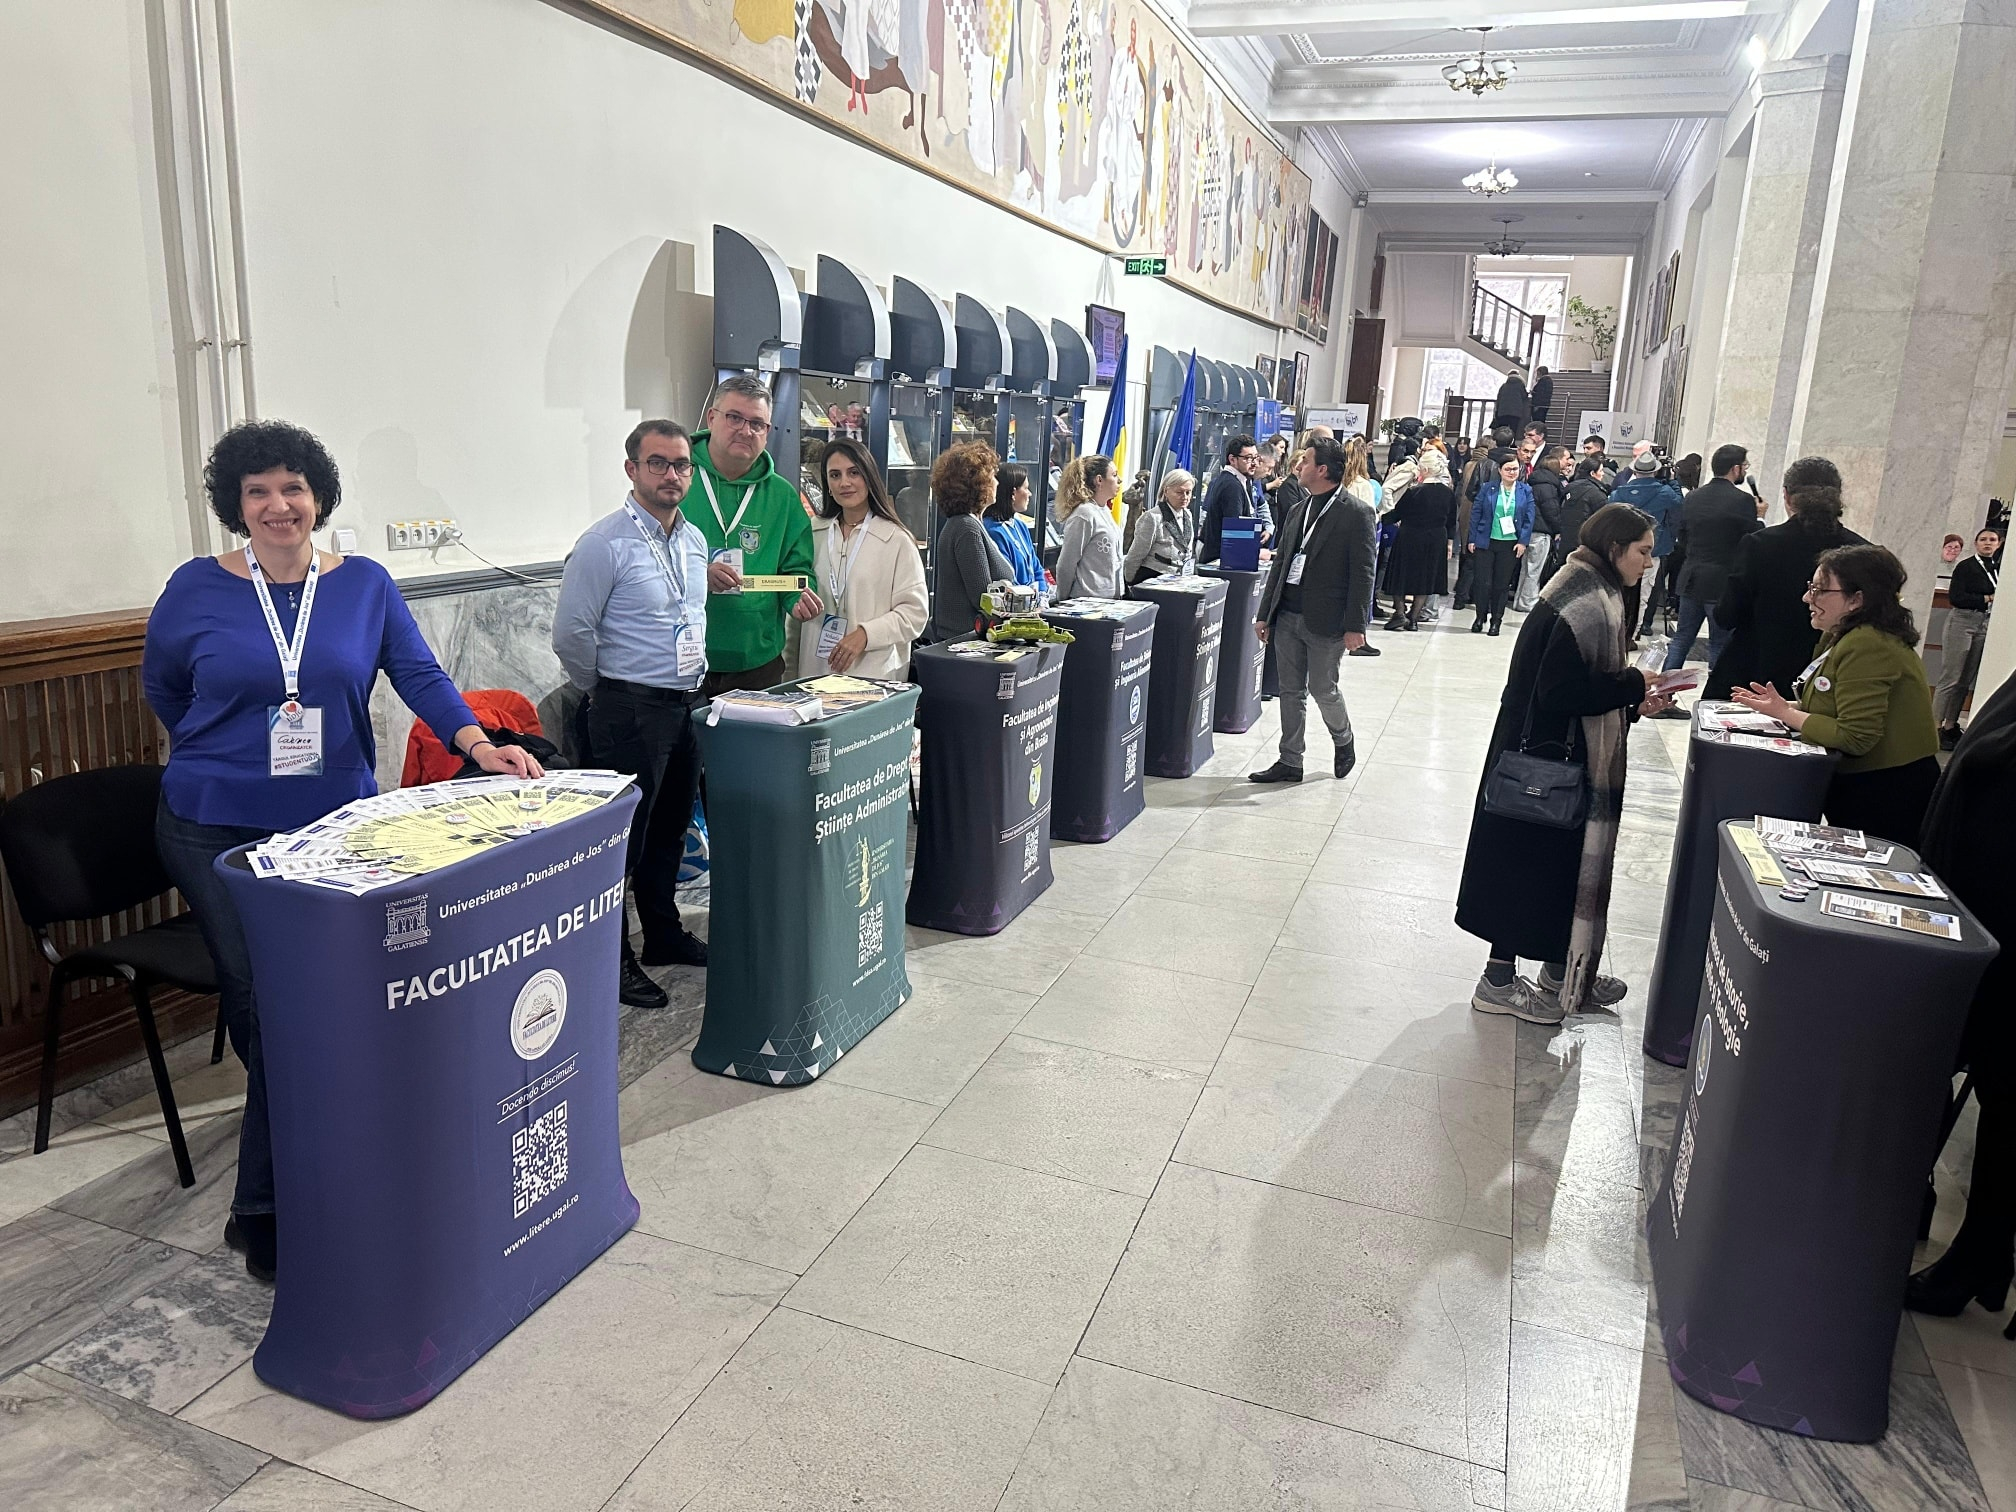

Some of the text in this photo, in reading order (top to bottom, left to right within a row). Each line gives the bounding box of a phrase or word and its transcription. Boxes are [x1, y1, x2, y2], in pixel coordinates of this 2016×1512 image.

[1127, 261, 1140, 272] EXIT
[1003, 709, 1037, 728] Facultatea
[1037, 700, 1044, 715] de
[1020, 712, 1054, 744] și Agronomie
[834, 739, 867, 757] Universitatea
[1024, 740, 1034, 756] din
[815, 756, 908, 812] Facultatea de Drept
[815, 811, 853, 845] Științe
[439, 880, 518, 919] Universitatea
[571, 851, 585, 866] de
[607, 833, 622, 847] din
[385, 892, 429, 908] UNIVERSITAS
[387, 938, 429, 953] GALATIENSIS
[387, 923, 553, 1010] FACULTATEA
[557, 905, 585, 940] DE
[1749, 937, 1770, 965] Galați
[1718, 954, 1726, 984] de
[1725, 967, 1750, 1030] Istorie,
[1714, 988, 1741, 1057] Teologie
[501, 1060, 576, 1116] Docendo discimus!
[503, 1194, 579, 1257] www.litere.ugal.ro
